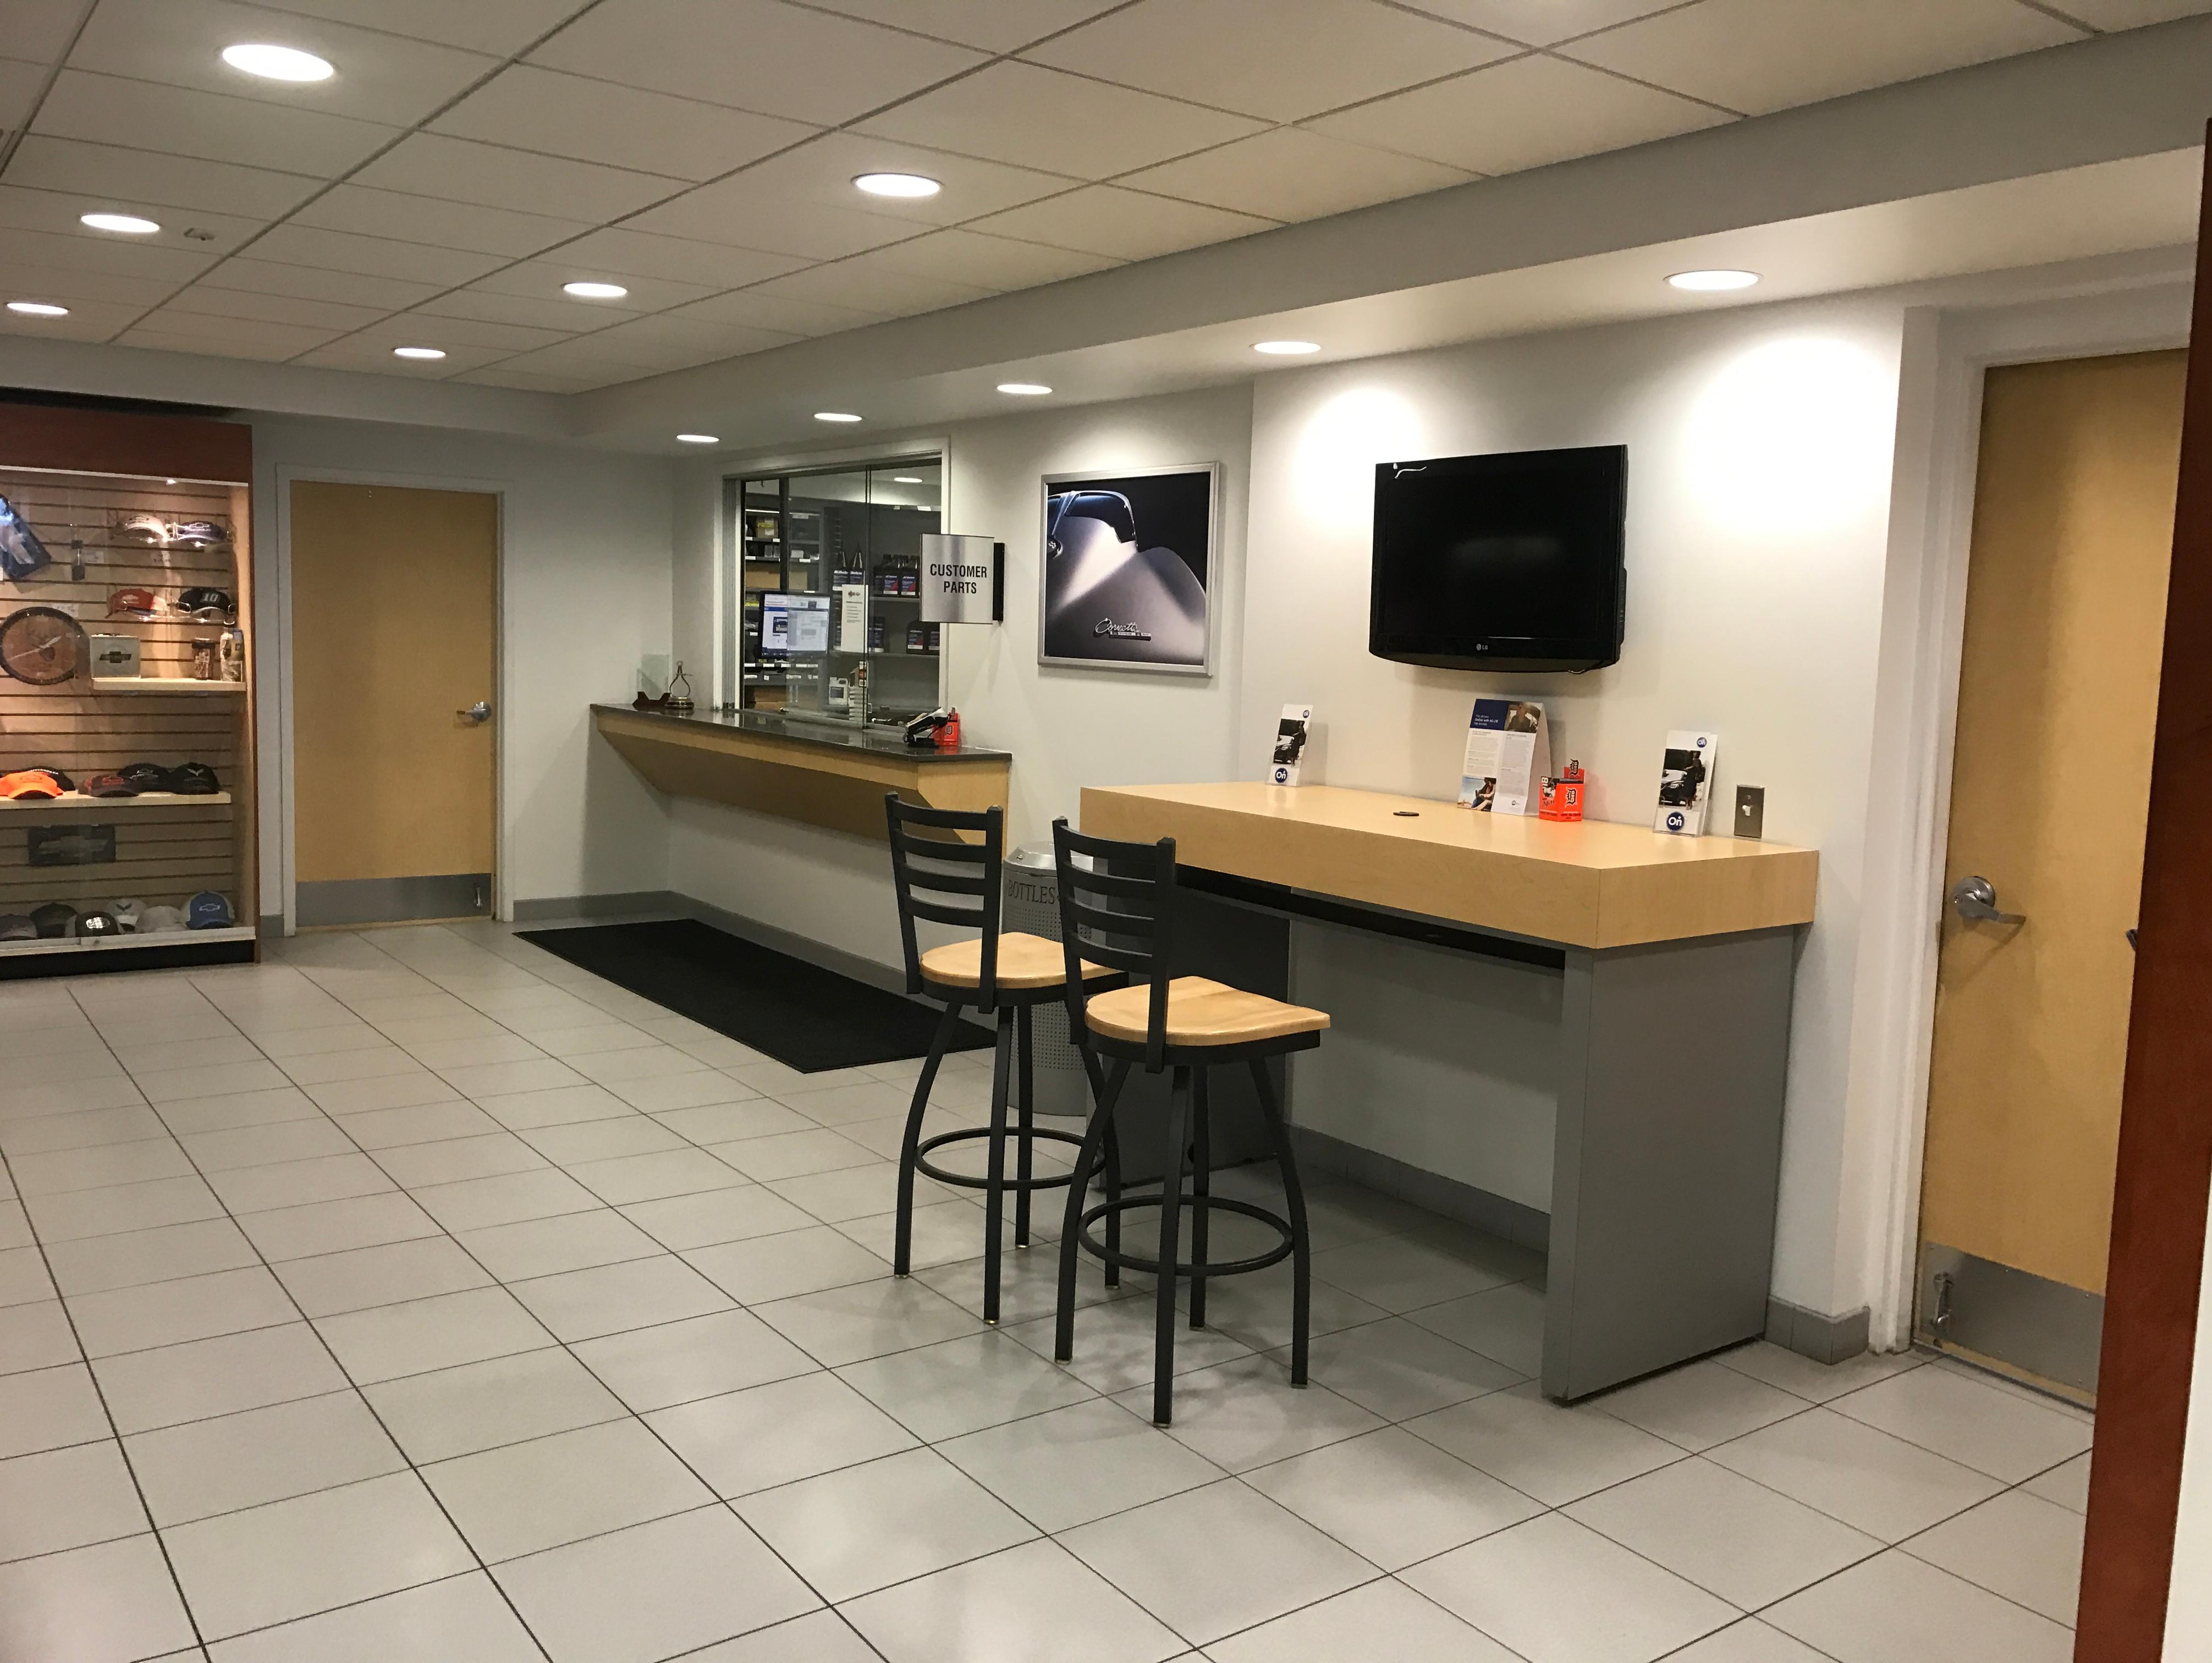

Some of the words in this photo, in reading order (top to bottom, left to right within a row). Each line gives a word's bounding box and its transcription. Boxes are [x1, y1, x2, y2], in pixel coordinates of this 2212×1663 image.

[930, 564, 987, 578] CUSTOMER
[943, 581, 977, 594] PARTS
[202, 593, 218, 602] 10
[1096, 618, 1140, 633] Corvette
[1276, 770, 1286, 779] On
[1668, 816, 1682, 827] On
[1008, 880, 1055, 904] BOTTLES
